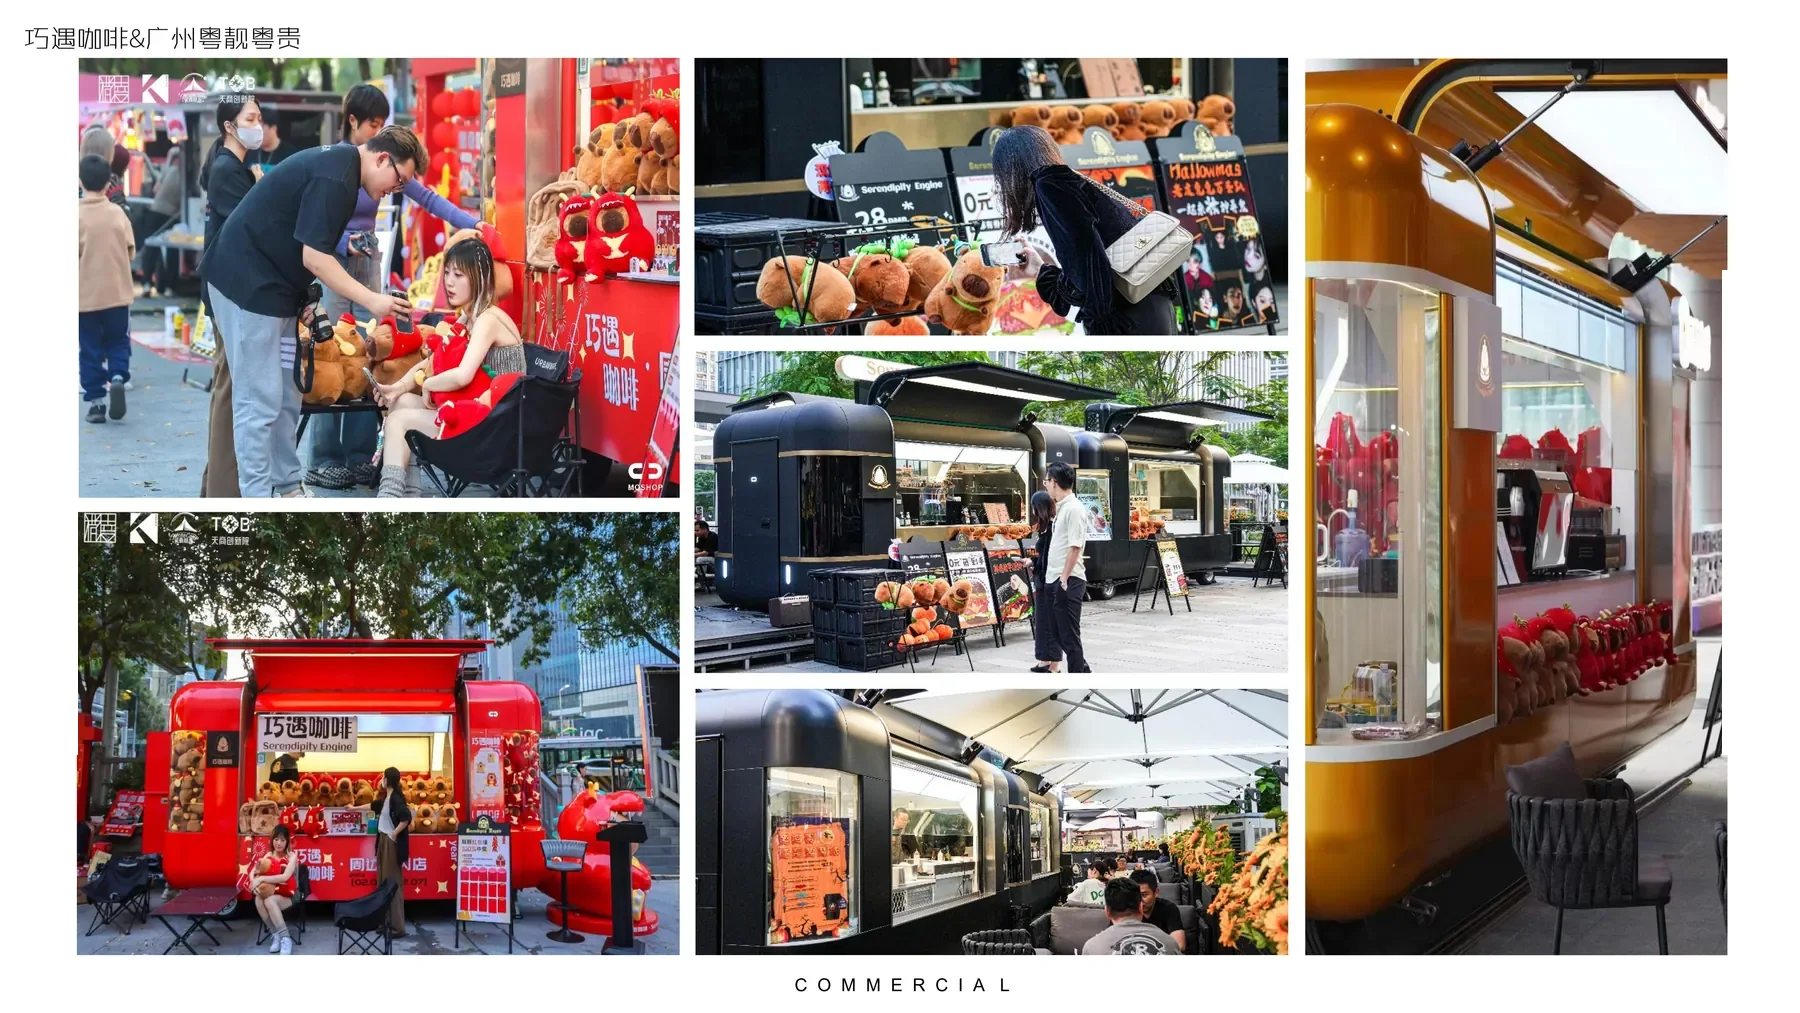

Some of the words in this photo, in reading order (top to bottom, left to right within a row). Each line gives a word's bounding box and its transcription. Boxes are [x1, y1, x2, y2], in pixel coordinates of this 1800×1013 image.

[860, 182, 912, 195] Serendipity
[914, 179, 943, 192] Engine
[1176, 195, 1249, 217] 一起来装神弄鬼
[584, 312, 620, 358] 巧遇
[602, 362, 639, 412] 咖啡
[263, 715, 353, 740] 巧遇咖啡
[263, 741, 318, 753] Serendipity
[319, 742, 353, 753] Engine
[448, 840, 458, 862] year
